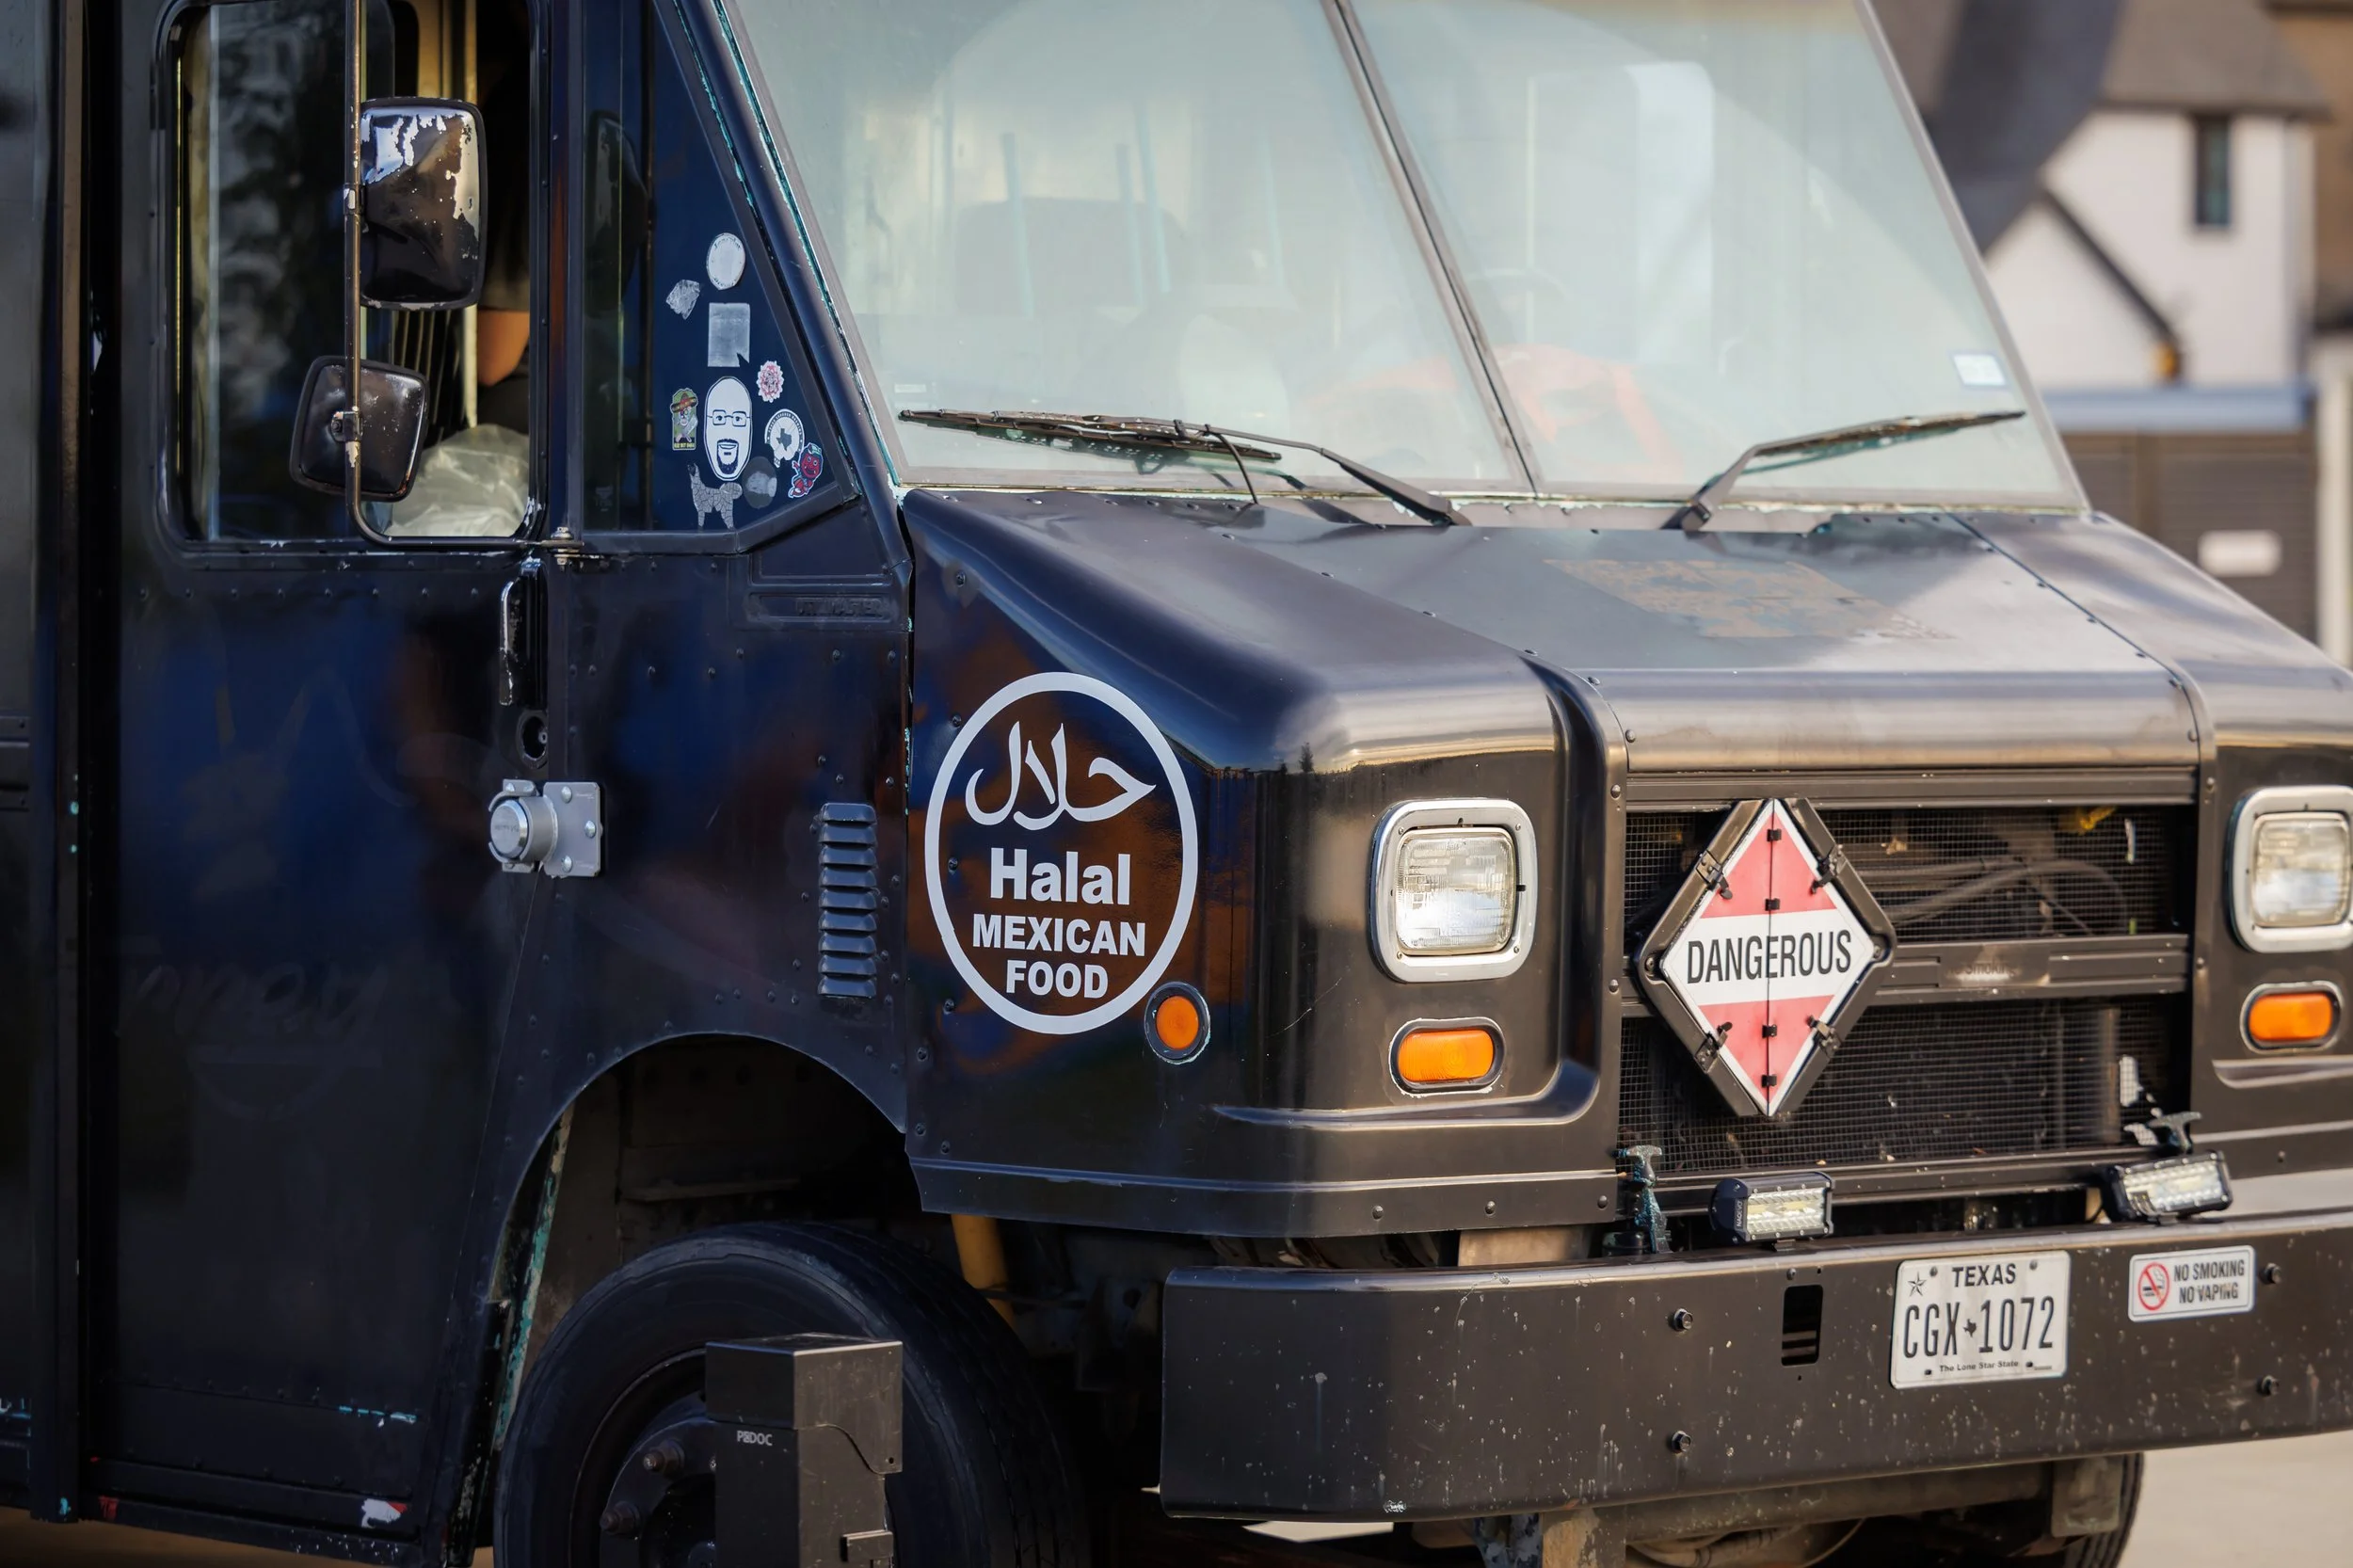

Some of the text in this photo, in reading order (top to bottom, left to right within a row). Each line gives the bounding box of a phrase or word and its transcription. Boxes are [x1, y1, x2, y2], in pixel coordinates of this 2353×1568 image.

[990, 847, 1130, 904] Halal
[972, 913, 1146, 957] MEXICAN
[1687, 929, 1852, 984] DANGEROUS
[1005, 959, 1109, 999] FOOD
[1951, 1263, 2016, 1288] TEXAS
[2174, 1259, 2245, 1281] NO SMOKING
[2179, 1282, 2239, 1304] NO VAPING
[1903, 1295, 2055, 1358] CGX 1072
[1957, 1363, 1977, 1371] Lone
[1978, 1361, 1994, 1369] Star
[1997, 1360, 2019, 1368] State
